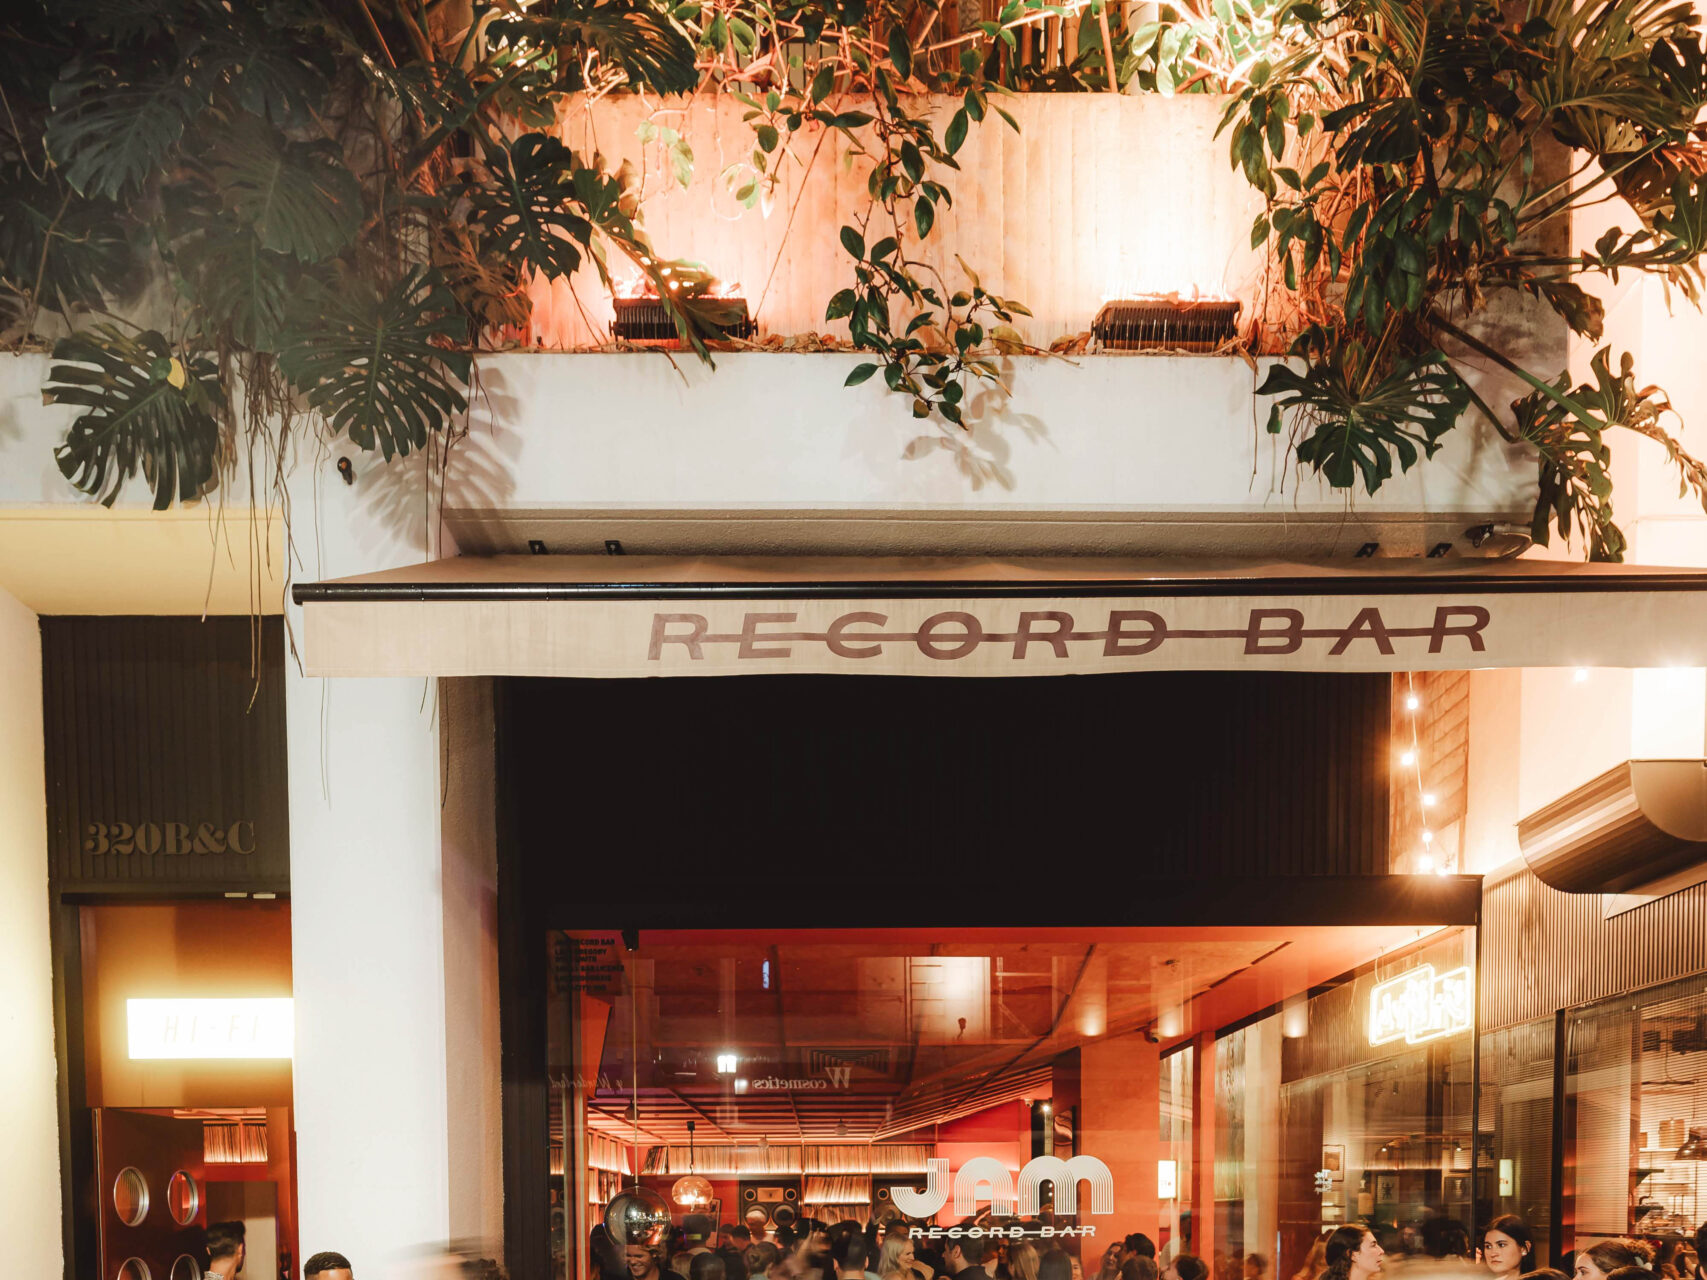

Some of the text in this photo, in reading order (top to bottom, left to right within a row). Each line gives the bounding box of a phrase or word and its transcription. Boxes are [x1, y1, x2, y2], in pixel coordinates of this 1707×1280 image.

[647, 606, 1491, 660] RECORD BAR
[85, 820, 256, 856] 320B&C
[163, 1013, 259, 1044] HI-FI
[908, 1225, 1097, 1240] RECORD BAR
